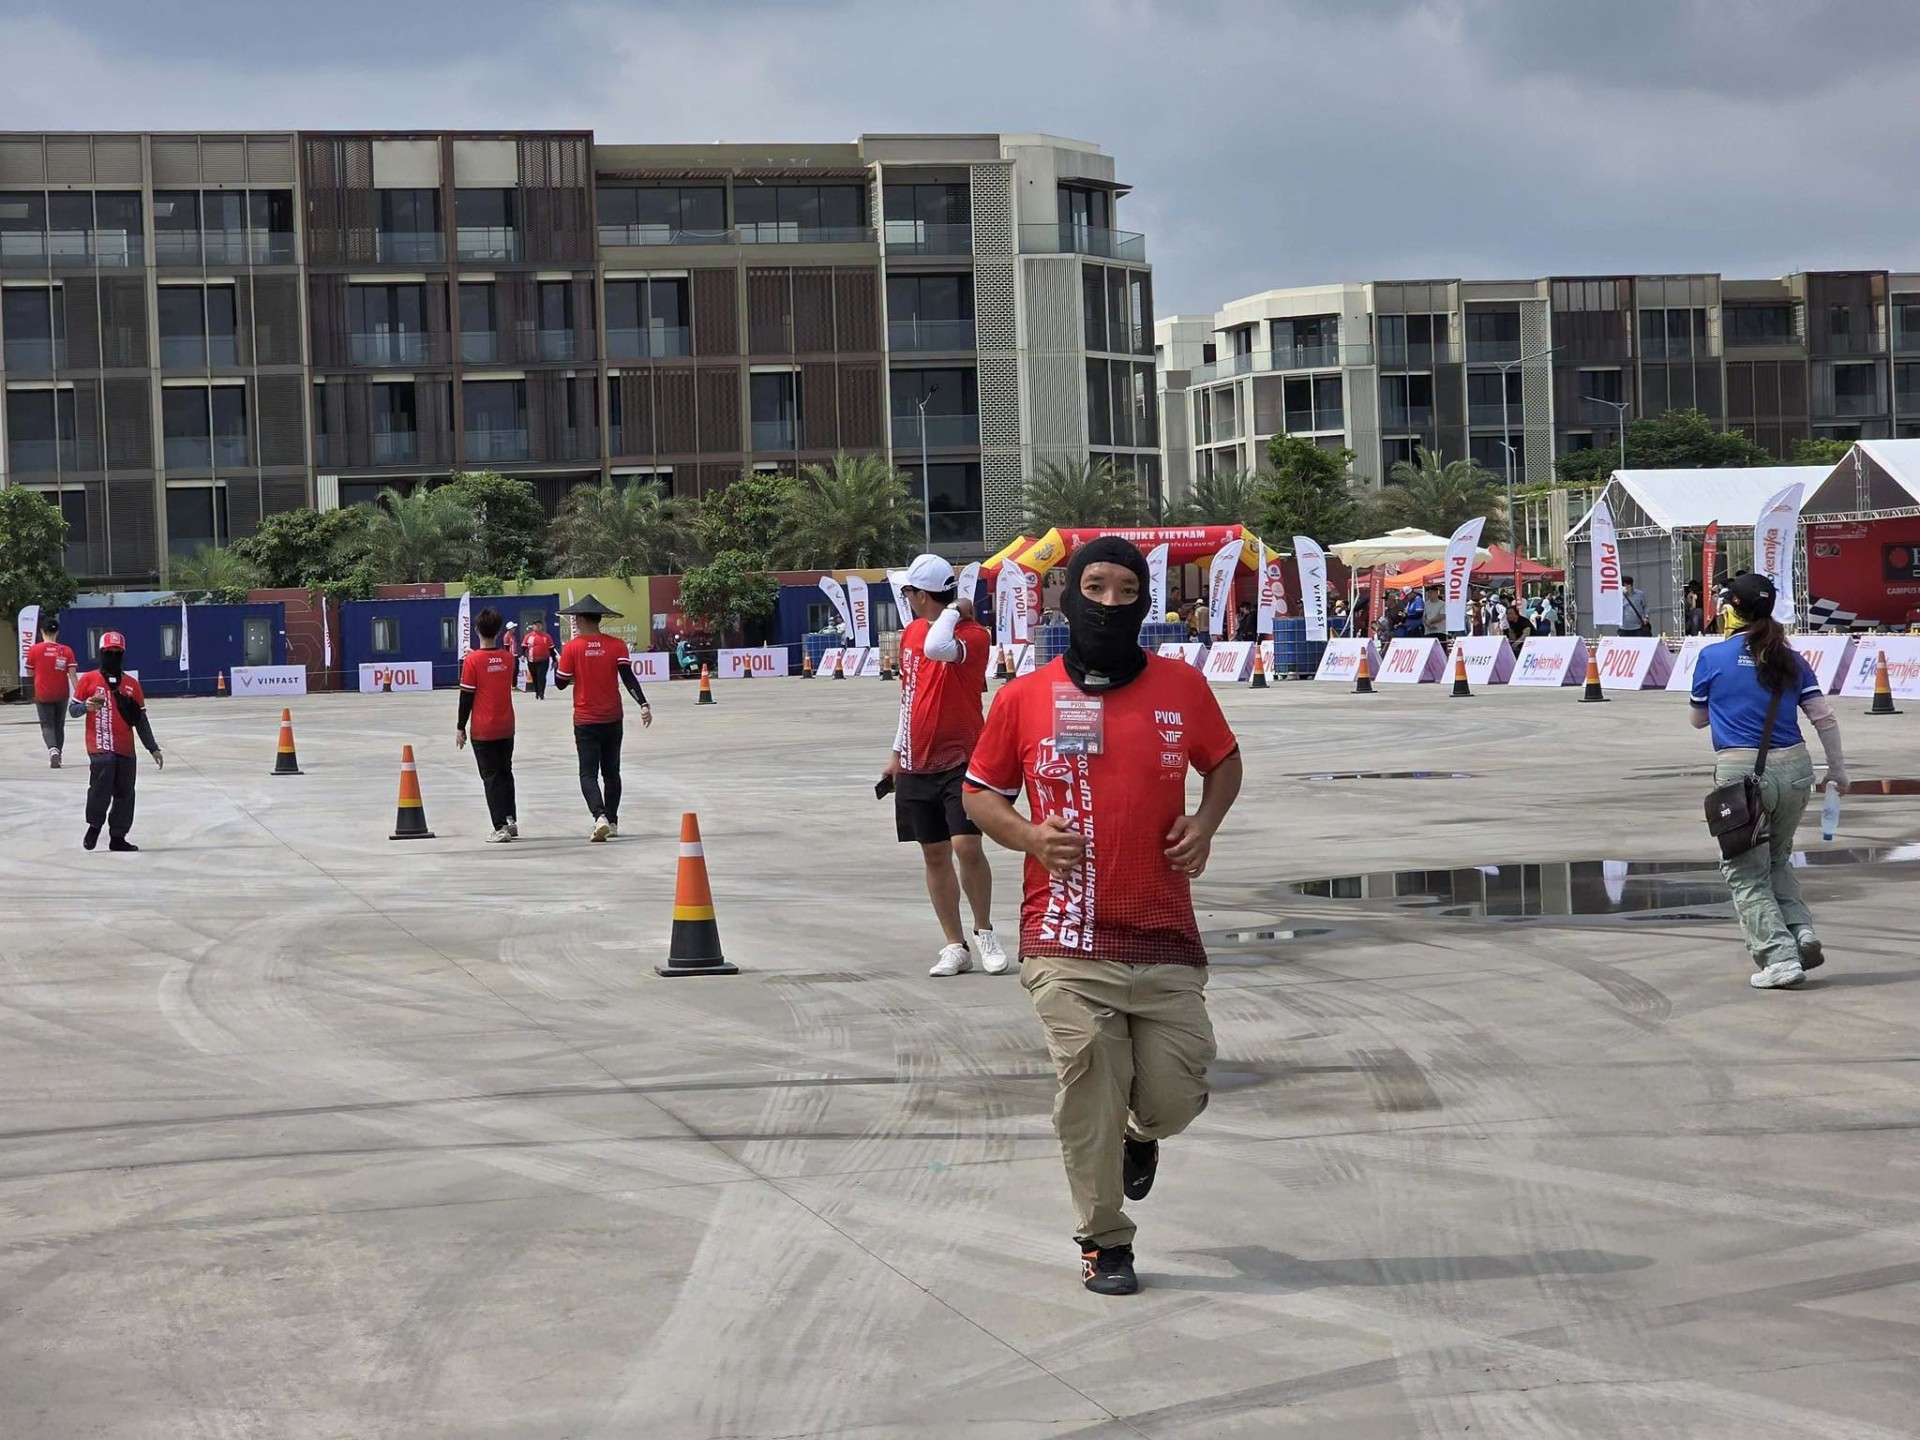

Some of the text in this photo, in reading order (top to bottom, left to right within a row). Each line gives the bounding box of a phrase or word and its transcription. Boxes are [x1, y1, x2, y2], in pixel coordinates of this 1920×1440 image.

[1157, 530, 1206, 540] VIETNAM
[1601, 542, 1619, 594] PVOIL
[1763, 528, 1781, 586] okemika
[1012, 586, 1026, 619] PVOIL
[1151, 587, 1159, 623] VINFAS
[1886, 587, 1917, 595] CAMPUS
[854, 601, 867, 630] PVOIL
[1313, 584, 1325, 628] VINFAST
[462, 616, 470, 650] PVOIL
[634, 660, 657, 676] OIL
[732, 655, 775, 671] PVOIL
[1210, 651, 1239, 673] PVOIL
[1387, 649, 1420, 673] PVOIL
[1599, 649, 1641, 677] PVOIL
[1859, 656, 1920, 685] Ekemika
[257, 677, 299, 685] VINFAST
[1154, 710, 1183, 726] PVOIL
[1077, 753, 1089, 776] 202
[1079, 779, 1093, 811] CUP
